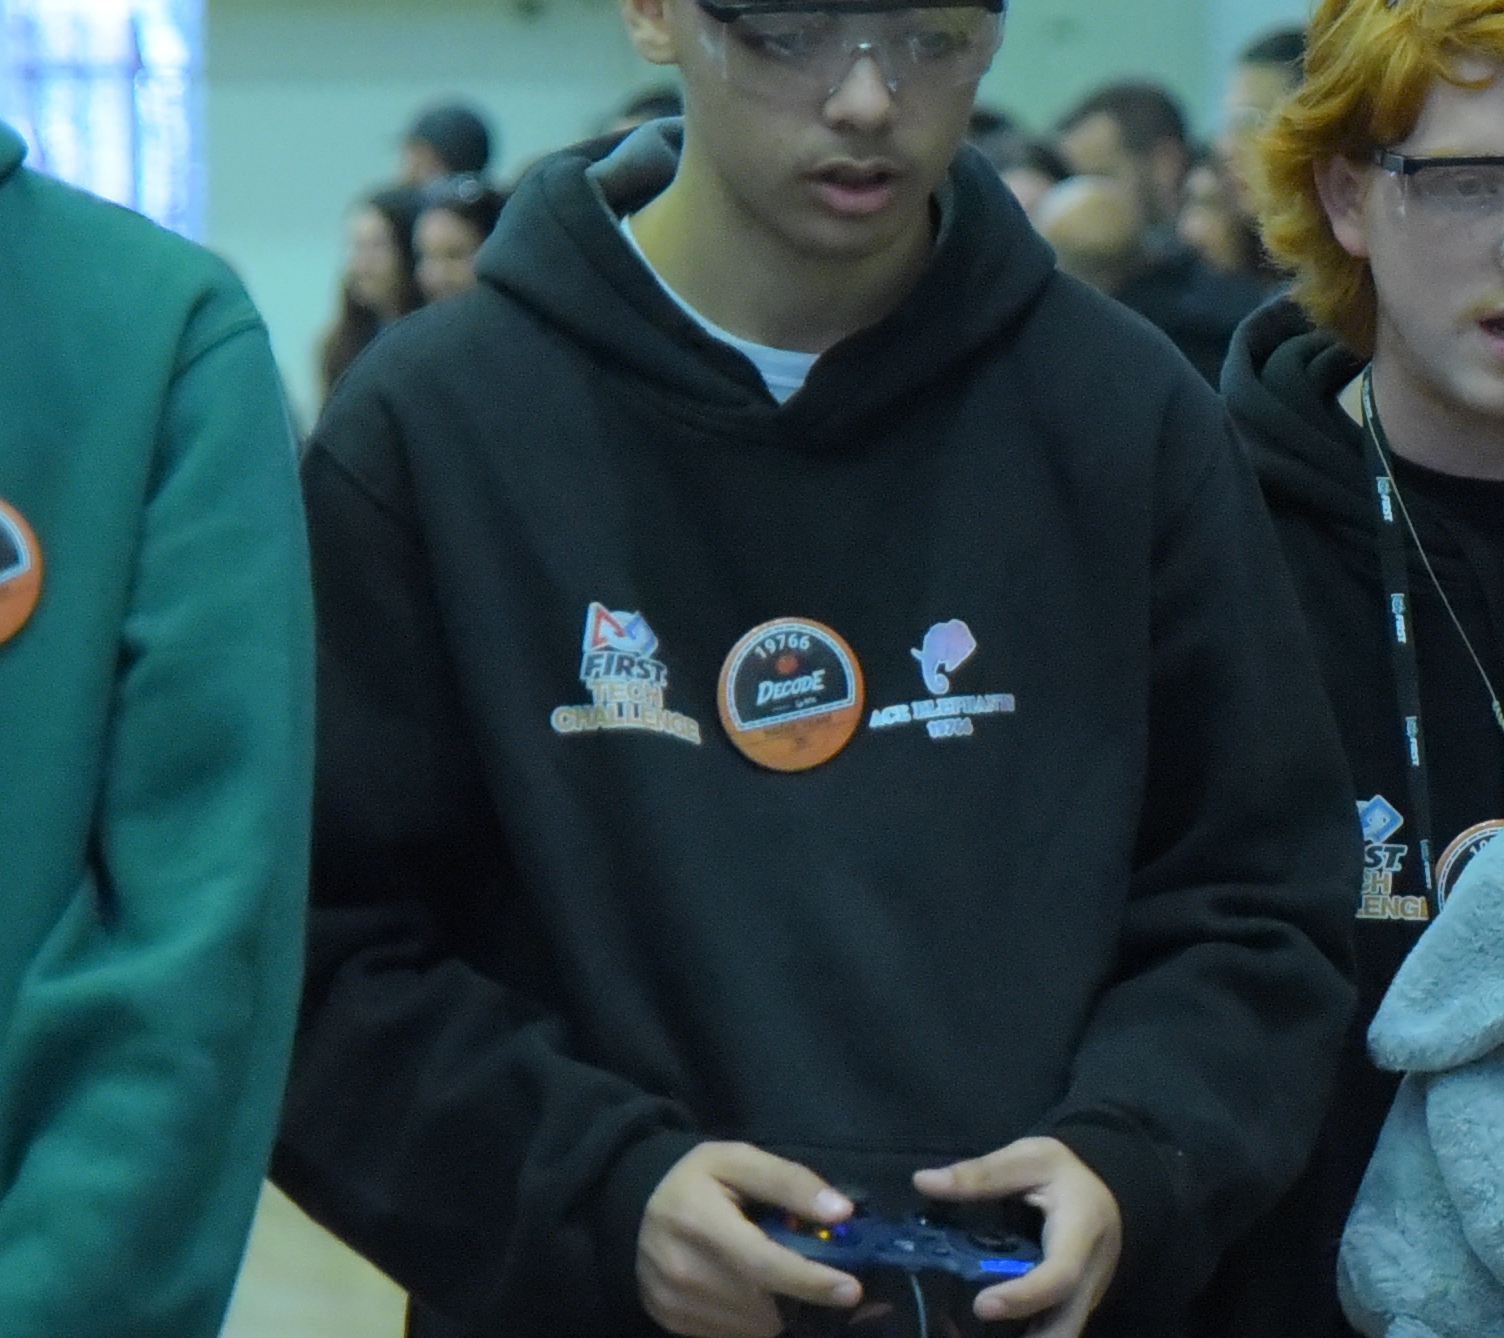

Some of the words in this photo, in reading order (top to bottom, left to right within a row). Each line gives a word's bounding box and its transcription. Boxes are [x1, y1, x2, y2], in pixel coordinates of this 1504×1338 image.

[754, 633, 810, 659] 19766
[581, 652, 667, 686] FIRST
[592, 680, 664, 708] TECH
[755, 669, 825, 706] DECODE
[551, 702, 701, 744] CHALLENGE
